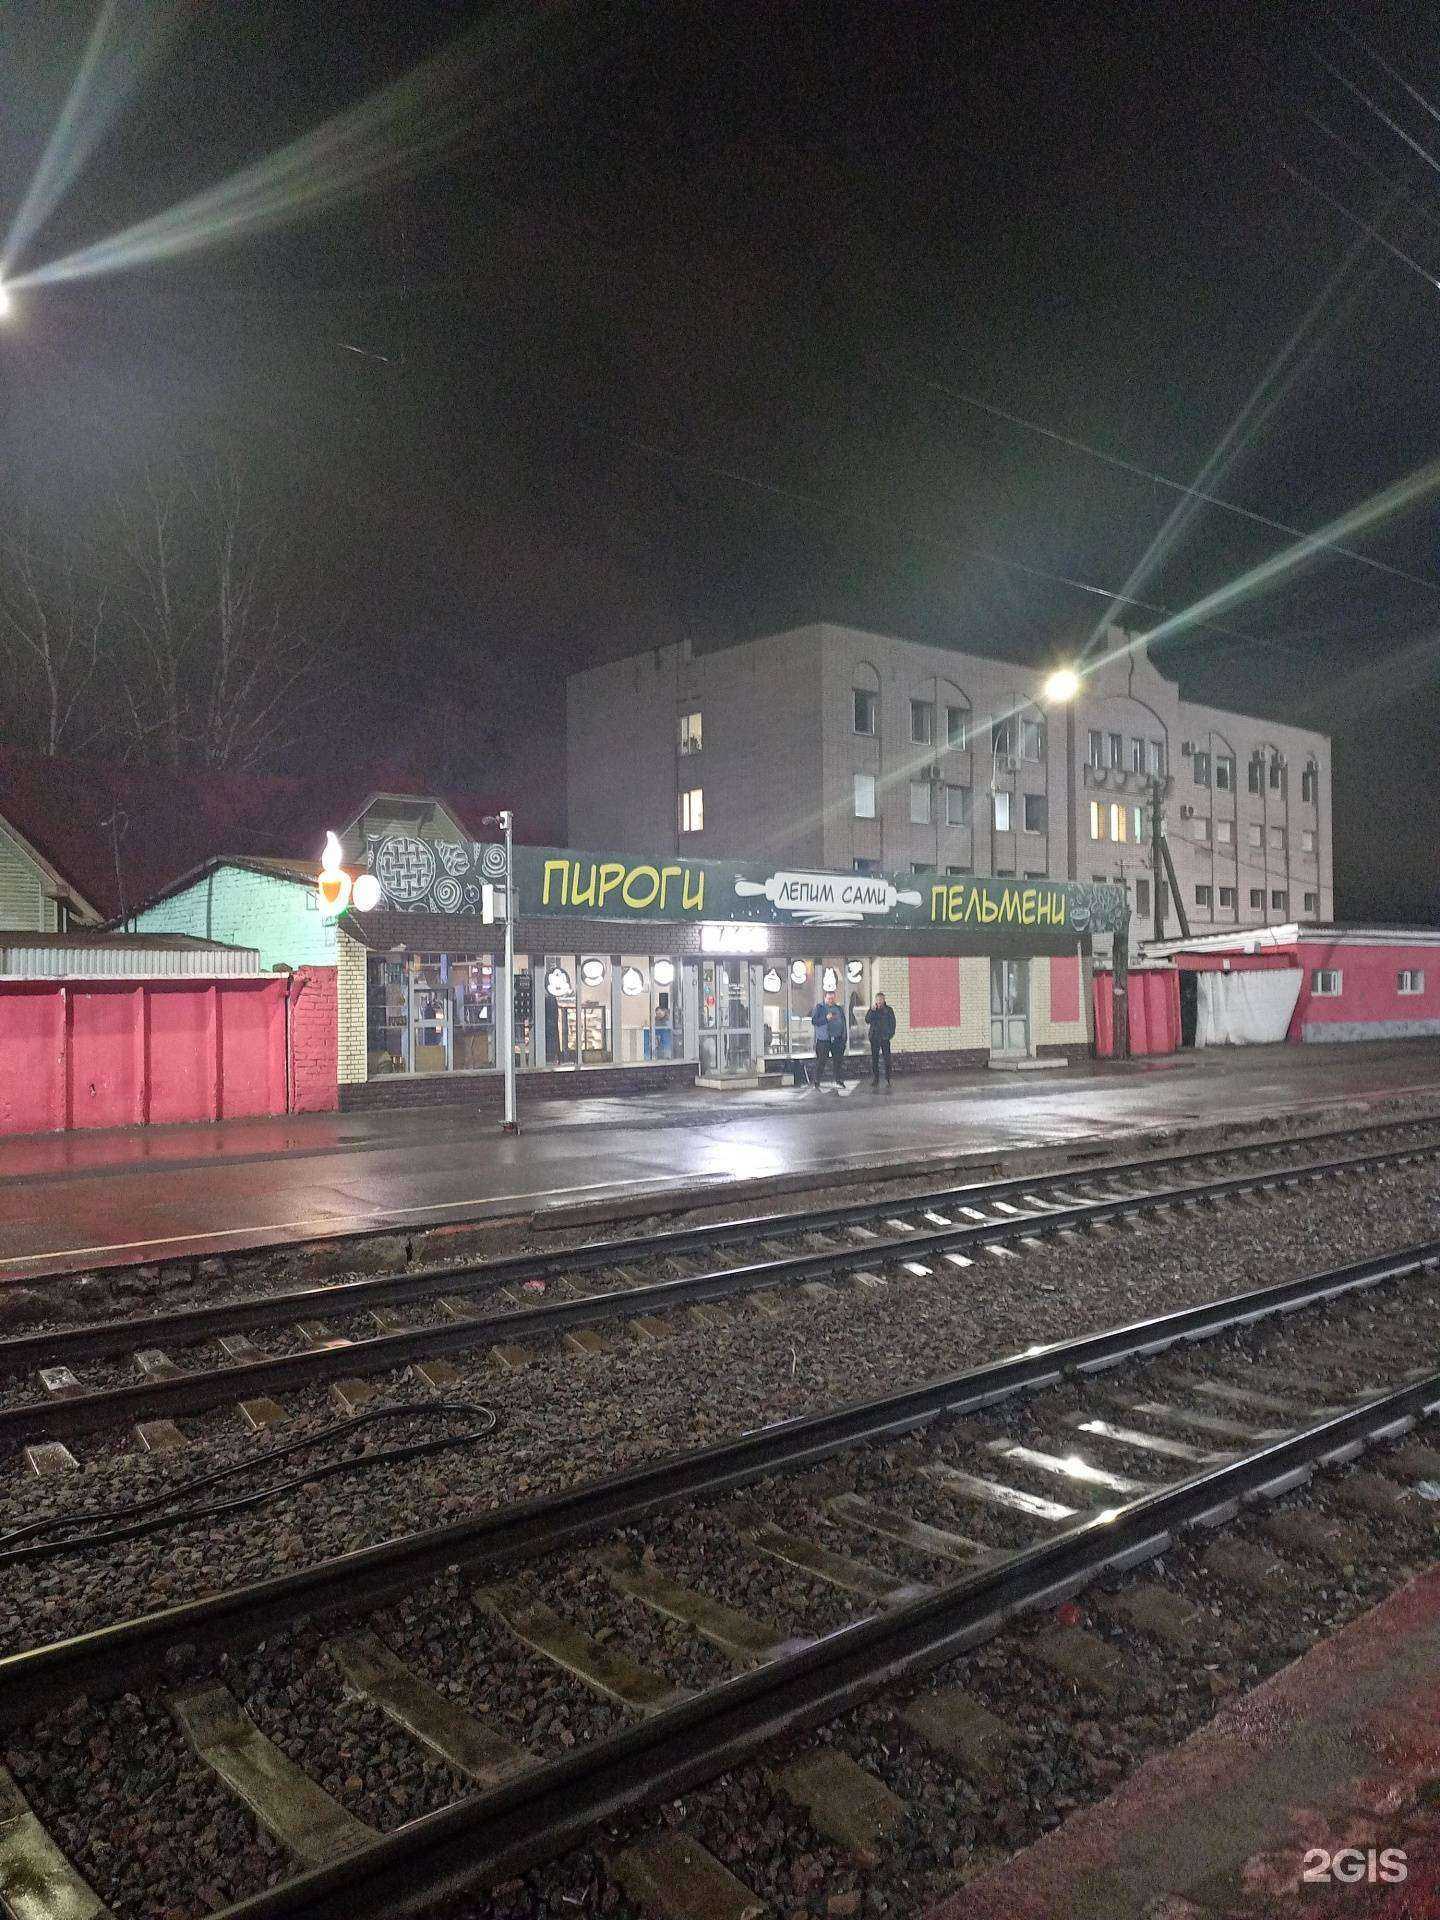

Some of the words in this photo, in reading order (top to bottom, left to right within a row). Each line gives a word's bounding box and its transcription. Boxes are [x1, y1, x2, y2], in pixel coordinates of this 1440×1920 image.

[542, 859, 705, 911] ПИРОГИ
[779, 881, 835, 903] ЛЕПИМ
[841, 886, 887, 906] САМИ
[931, 884, 1066, 926] ПЕЛЬМЕНИ
